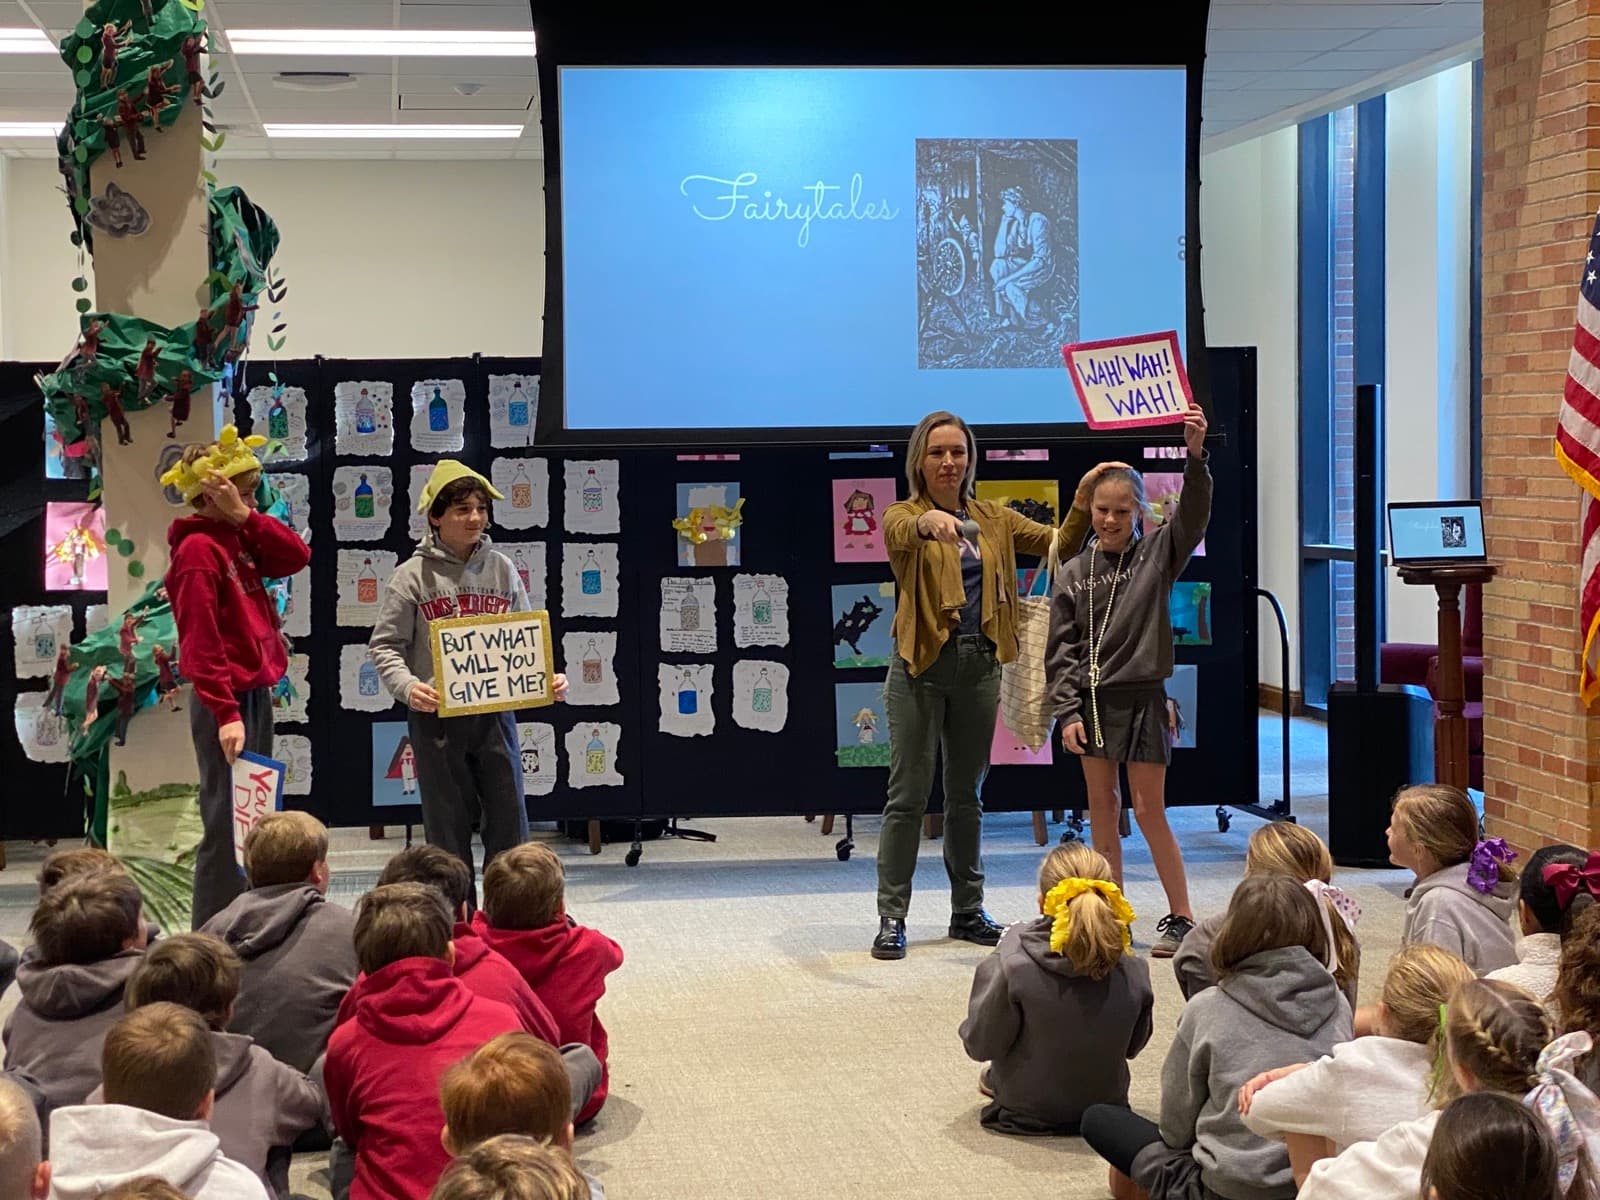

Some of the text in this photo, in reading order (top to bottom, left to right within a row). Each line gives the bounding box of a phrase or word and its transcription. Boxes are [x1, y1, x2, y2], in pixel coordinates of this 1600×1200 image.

[680, 172, 900, 248] Fairytales
[1075, 347, 1172, 388] WAH! WAH!
[1105, 380, 1181, 417] WAH!
[418, 593, 513, 622] UMS-WRIGHT
[440, 625, 540, 656] BUT WHAT
[450, 652, 536, 676] WILL YOU
[449, 671, 546, 704] GIVE ME?
